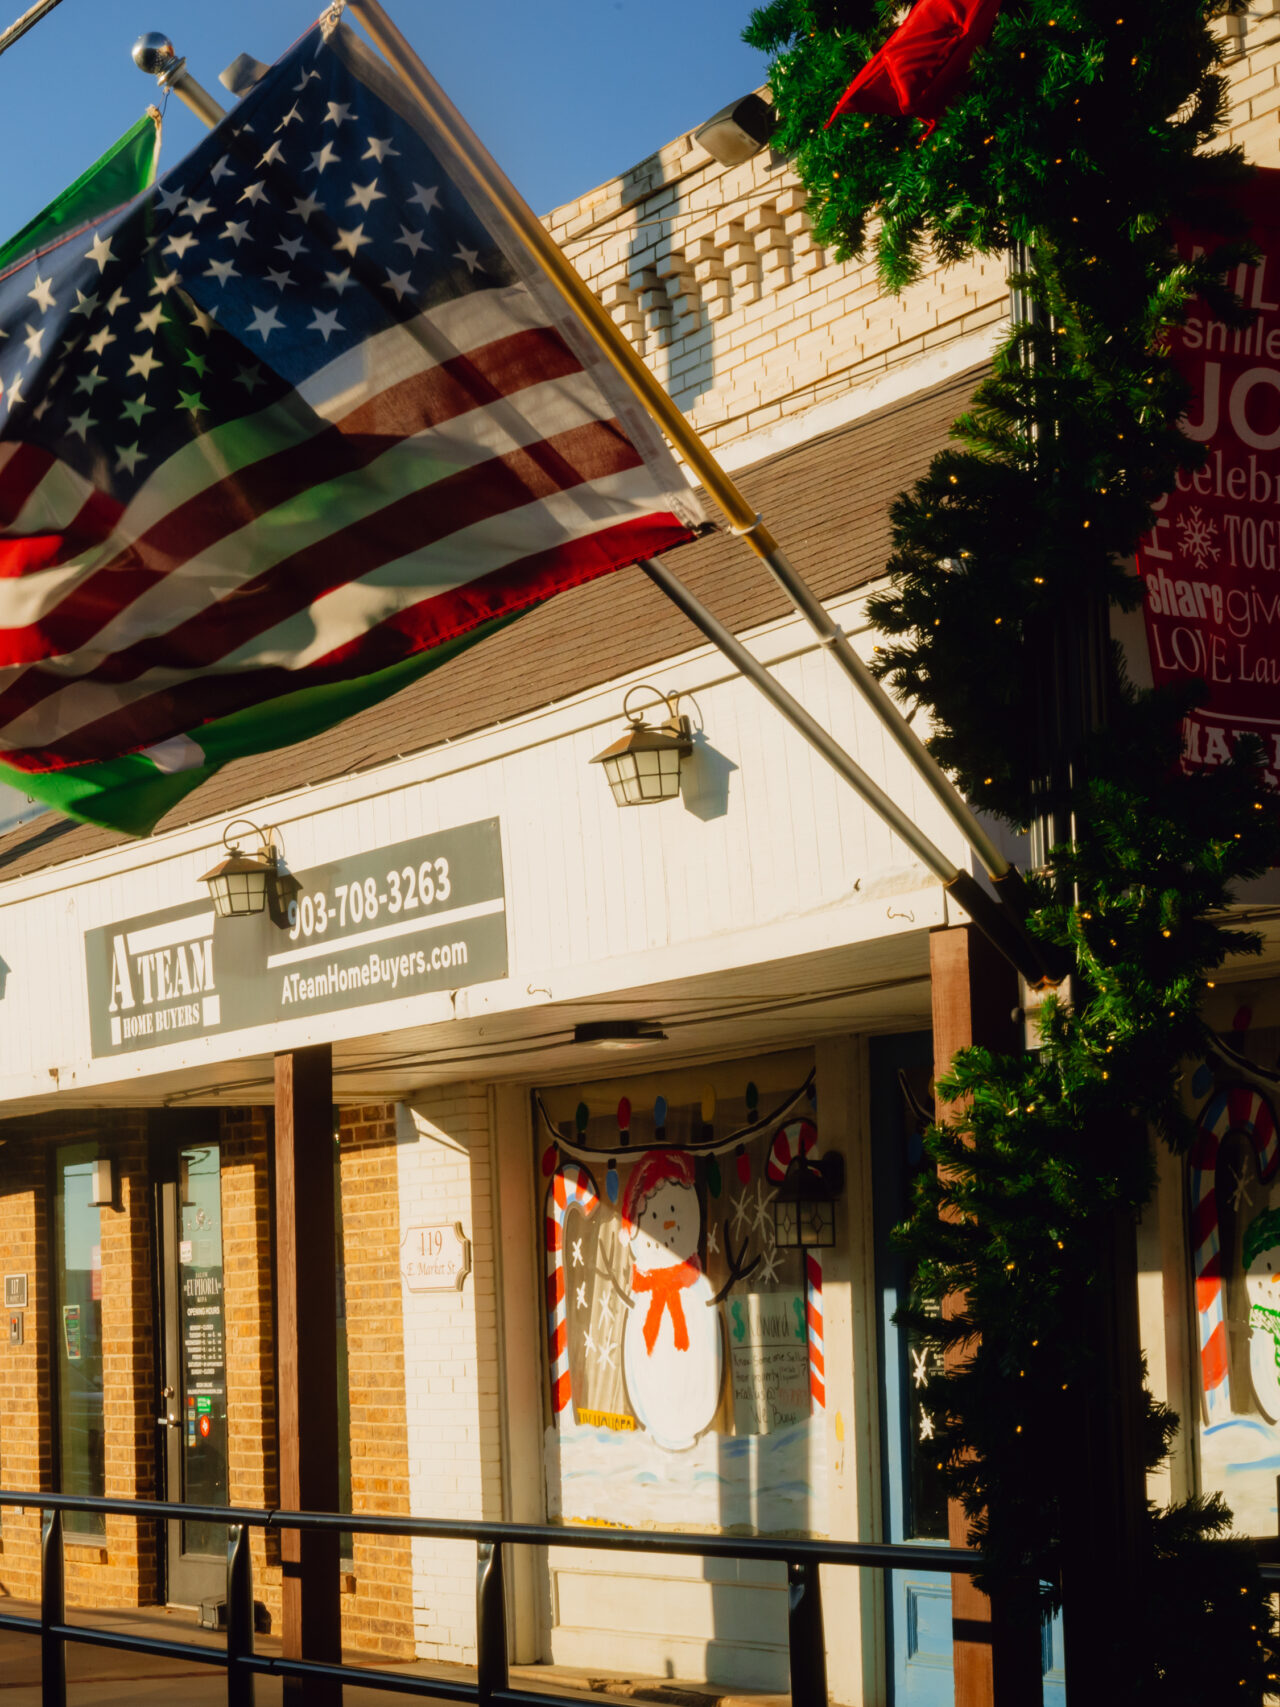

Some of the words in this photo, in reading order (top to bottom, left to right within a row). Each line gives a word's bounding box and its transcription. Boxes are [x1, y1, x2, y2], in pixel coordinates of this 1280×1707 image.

[1176, 361, 1280, 451] JO
[1175, 450, 1280, 503] celeb
[1224, 514, 1280, 571] TOG
[1146, 567, 1223, 625] share
[1227, 584, 1280, 638] giv
[1152, 623, 1231, 684] LOVE
[1238, 643, 1280, 685] Lau
[288, 857, 451, 940] 903-708-3263
[109, 934, 135, 1012] A
[137, 939, 215, 1005] TEAM
[281, 941, 468, 1005] ATeamHomeBuyers.com
[123, 1013, 153, 1038] HOME
[155, 1003, 199, 1032] BUYERS
[421, 1230, 442, 1256] 119
[187, 1278, 218, 1296] EUPHORIA
